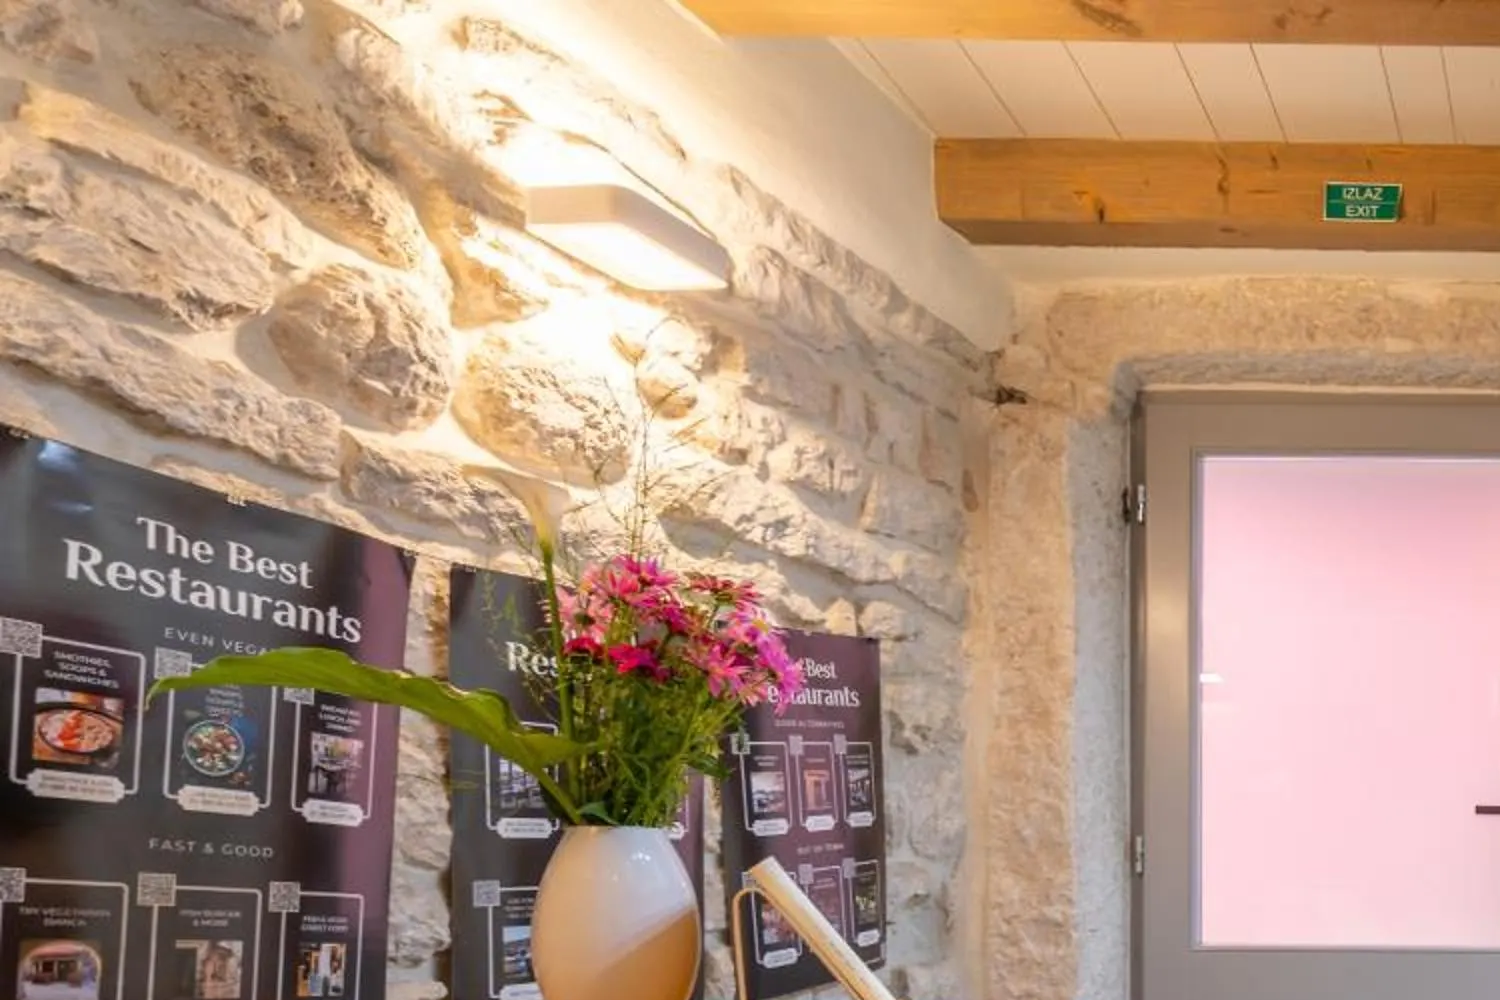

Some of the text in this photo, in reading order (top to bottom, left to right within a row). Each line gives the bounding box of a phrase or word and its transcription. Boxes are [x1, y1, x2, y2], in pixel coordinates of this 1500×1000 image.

[1343, 187, 1384, 200] IZLAZ
[1345, 205, 1379, 217] EXIT
[136, 516, 314, 589] The Best
[62, 538, 363, 644] Restaurants
[164, 626, 215, 647] EVEN
[148, 838, 274, 858] FAST & GOOD
